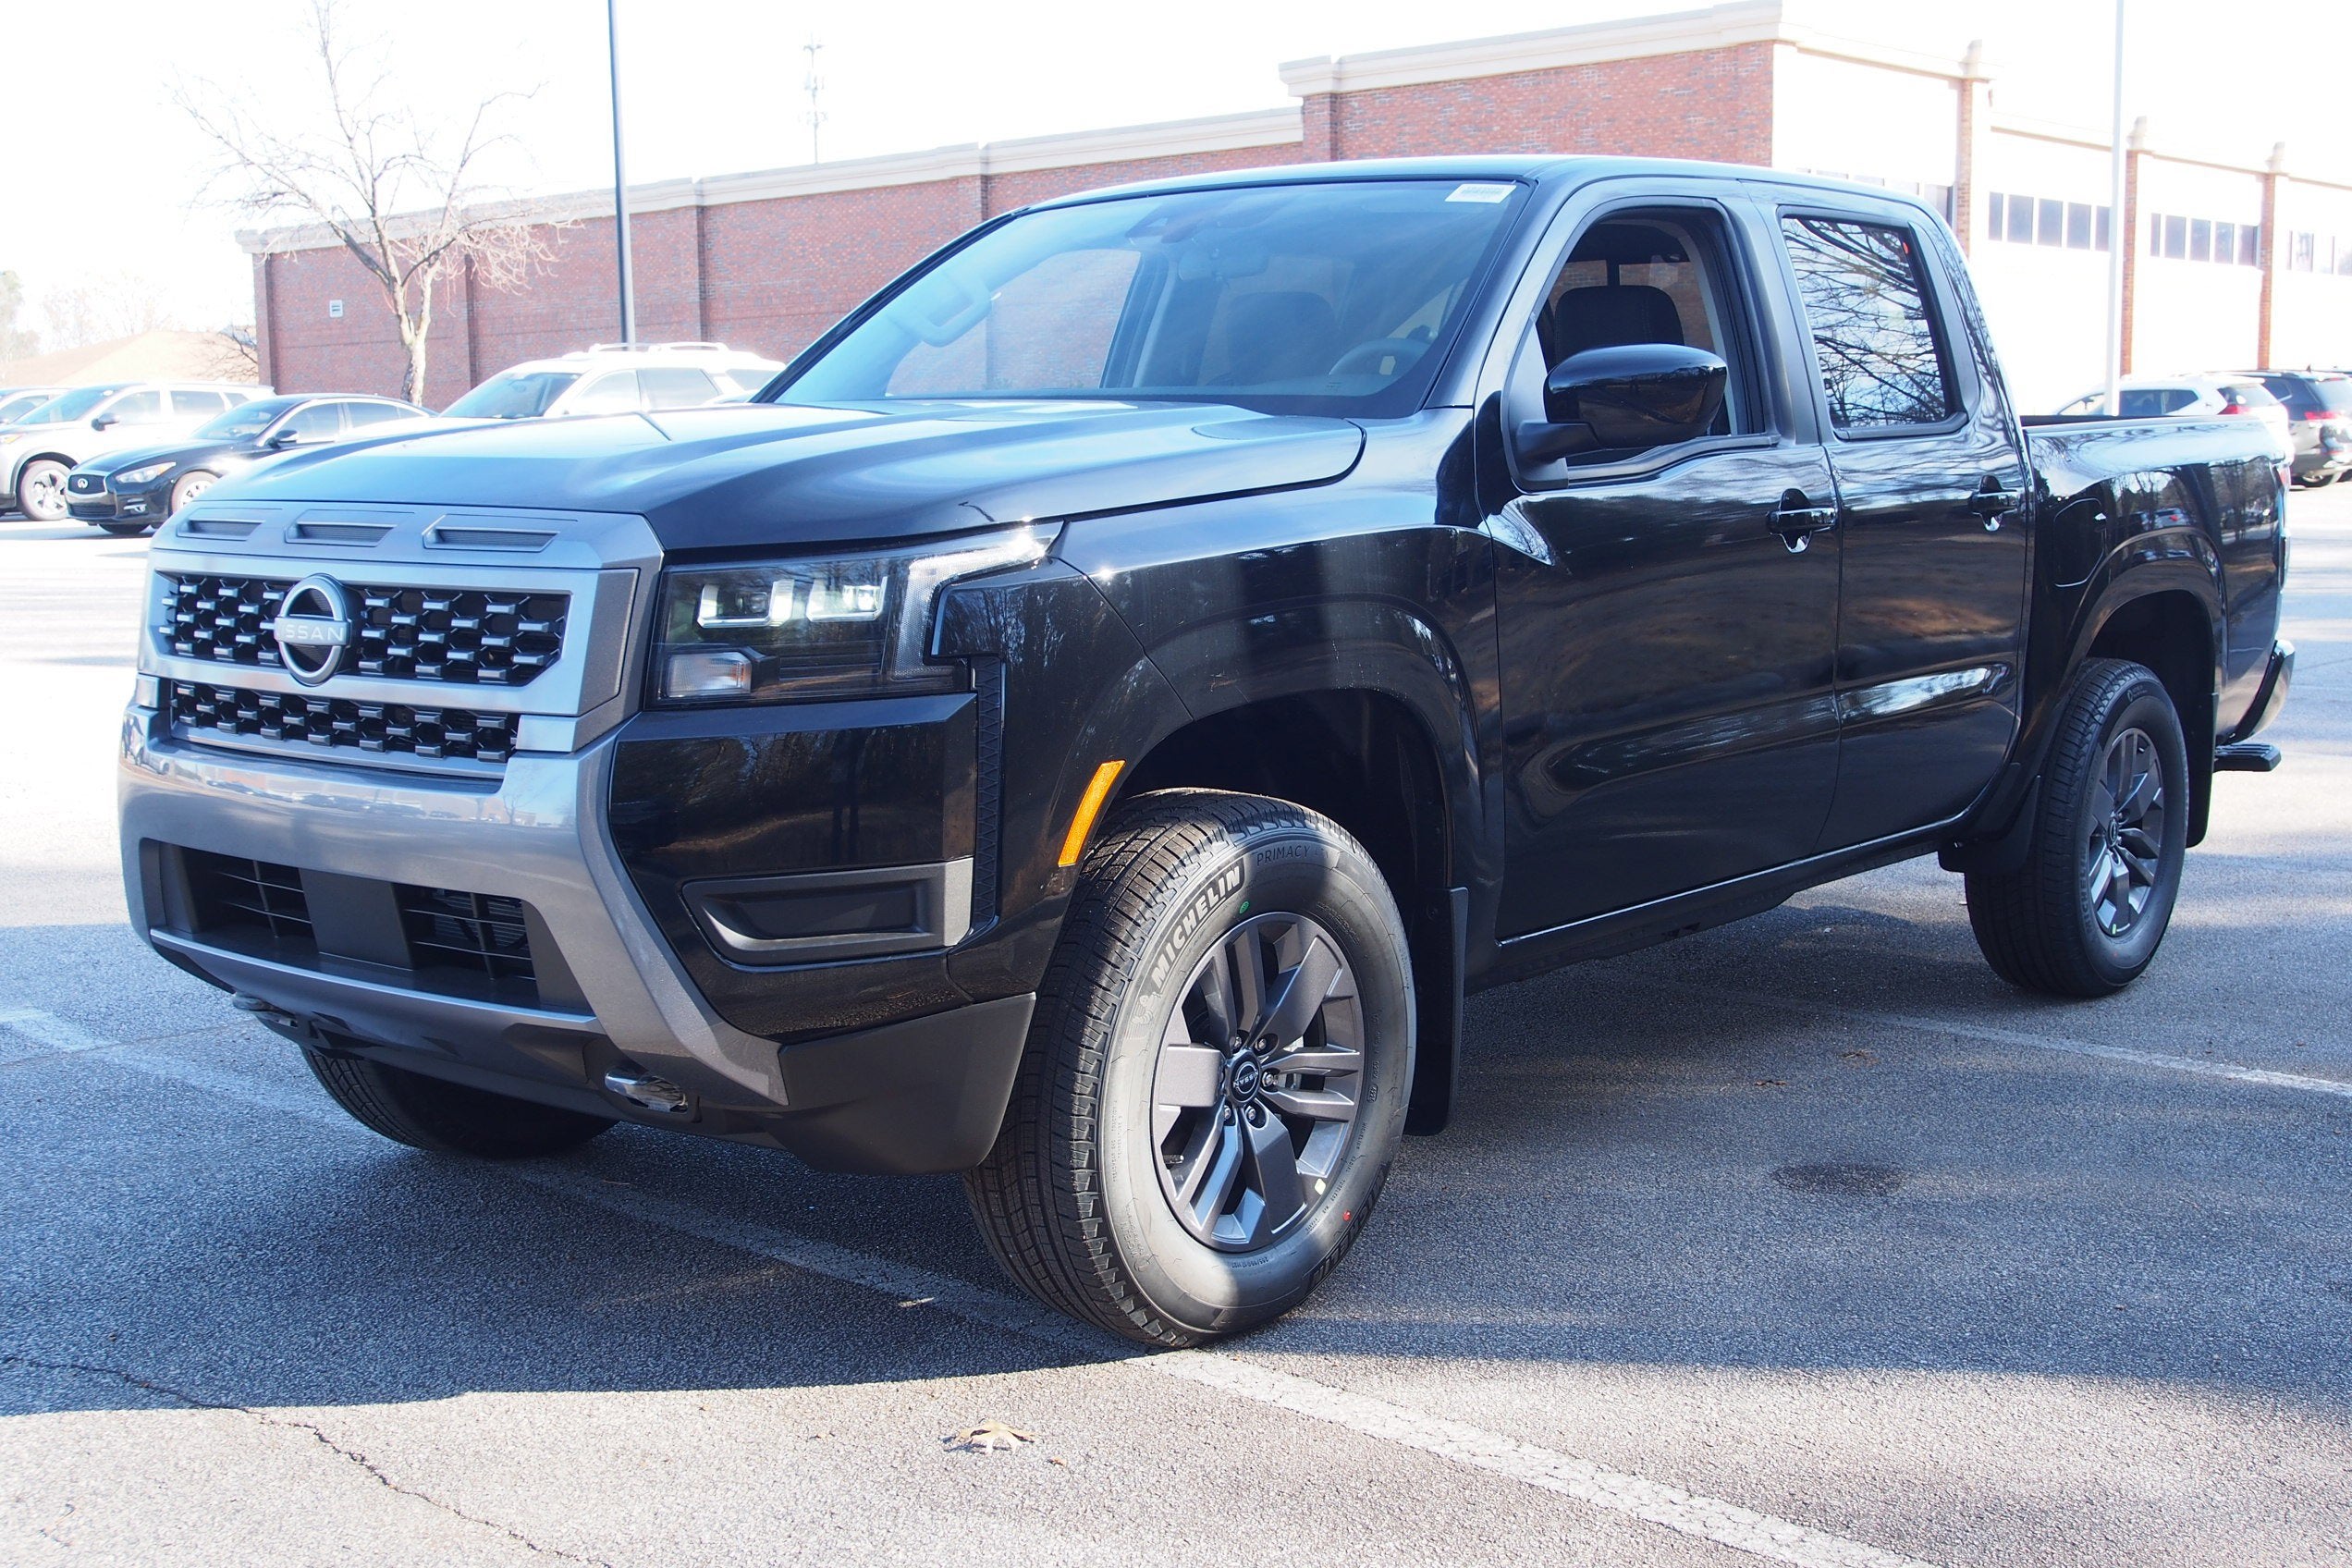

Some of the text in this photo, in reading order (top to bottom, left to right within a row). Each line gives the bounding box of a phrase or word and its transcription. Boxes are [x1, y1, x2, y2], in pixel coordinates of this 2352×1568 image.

[281, 623, 344, 642] SSAN
[1256, 844, 1312, 867] PRIMACY
[1149, 864, 1242, 989] MICHELIN
